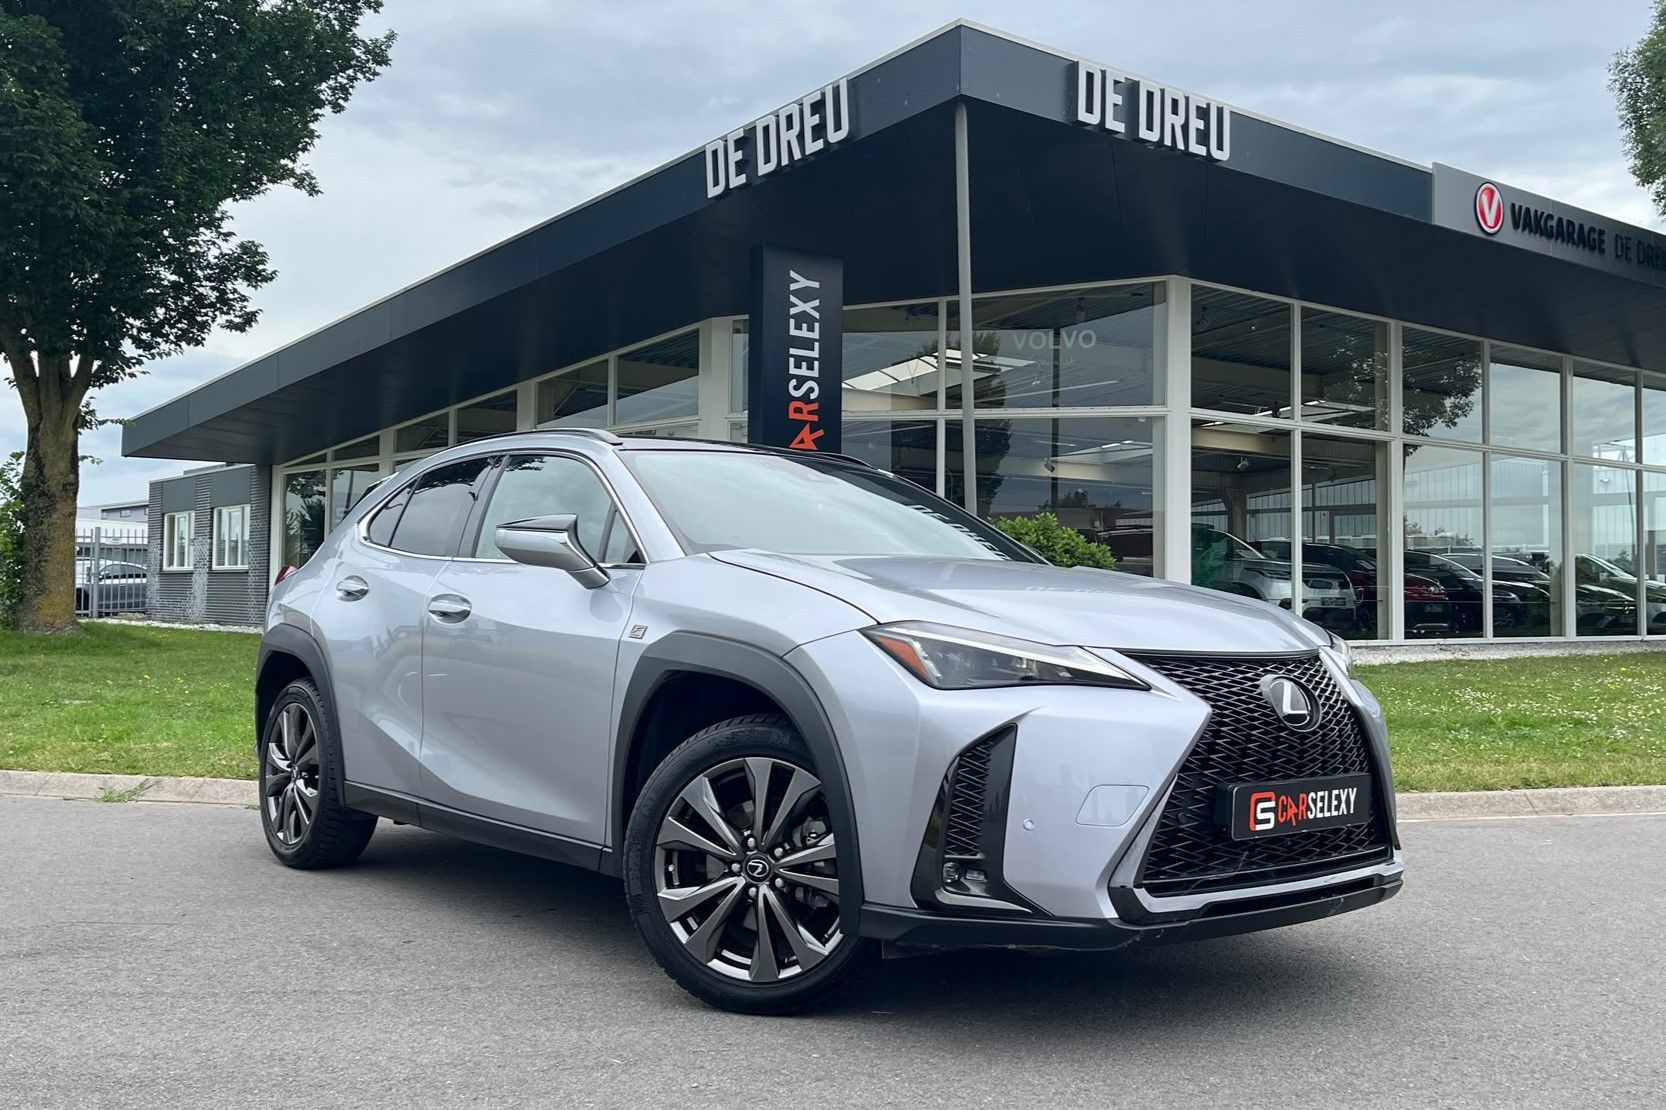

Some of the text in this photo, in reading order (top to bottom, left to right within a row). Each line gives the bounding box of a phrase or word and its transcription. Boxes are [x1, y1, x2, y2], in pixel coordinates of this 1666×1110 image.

[705, 78, 850, 199] DE DREU
[1077, 60, 1231, 162] DE DREU
[1510, 202, 1666, 271] VAKGARAGE DE DRE
[787, 269, 825, 451] ARSELEXY
[1012, 329, 1097, 350] VOLVO
[1278, 787, 1358, 826] CARSELEXY
